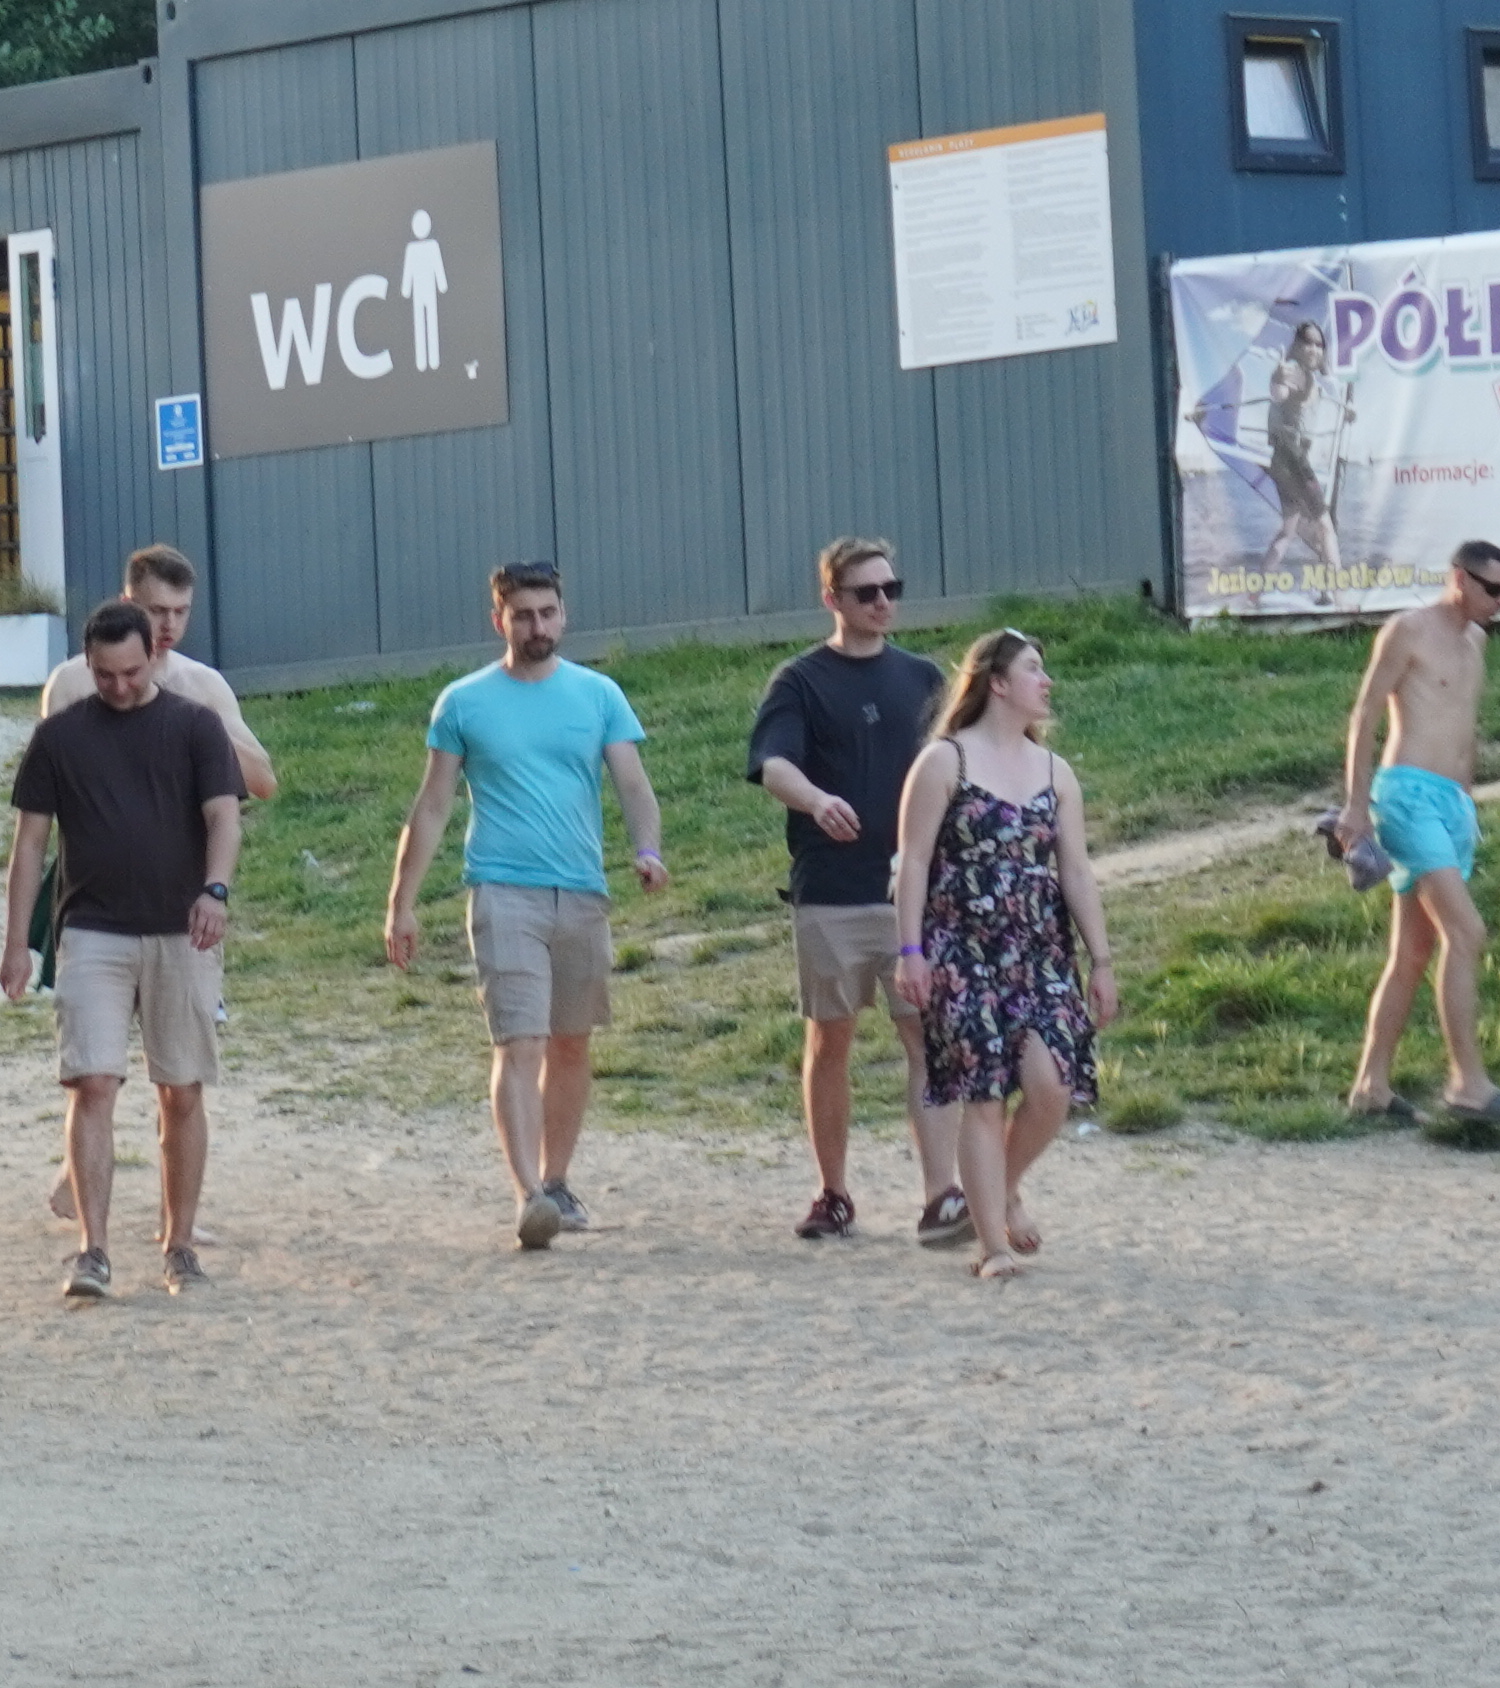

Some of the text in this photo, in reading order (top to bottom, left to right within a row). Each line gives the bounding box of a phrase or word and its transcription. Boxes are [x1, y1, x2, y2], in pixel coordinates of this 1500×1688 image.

[250, 274, 394, 391] WC
[1394, 459, 1494, 485] Informacje:
[1207, 566, 1295, 595] Jezioro
[1301, 560, 1416, 591] Mietków
